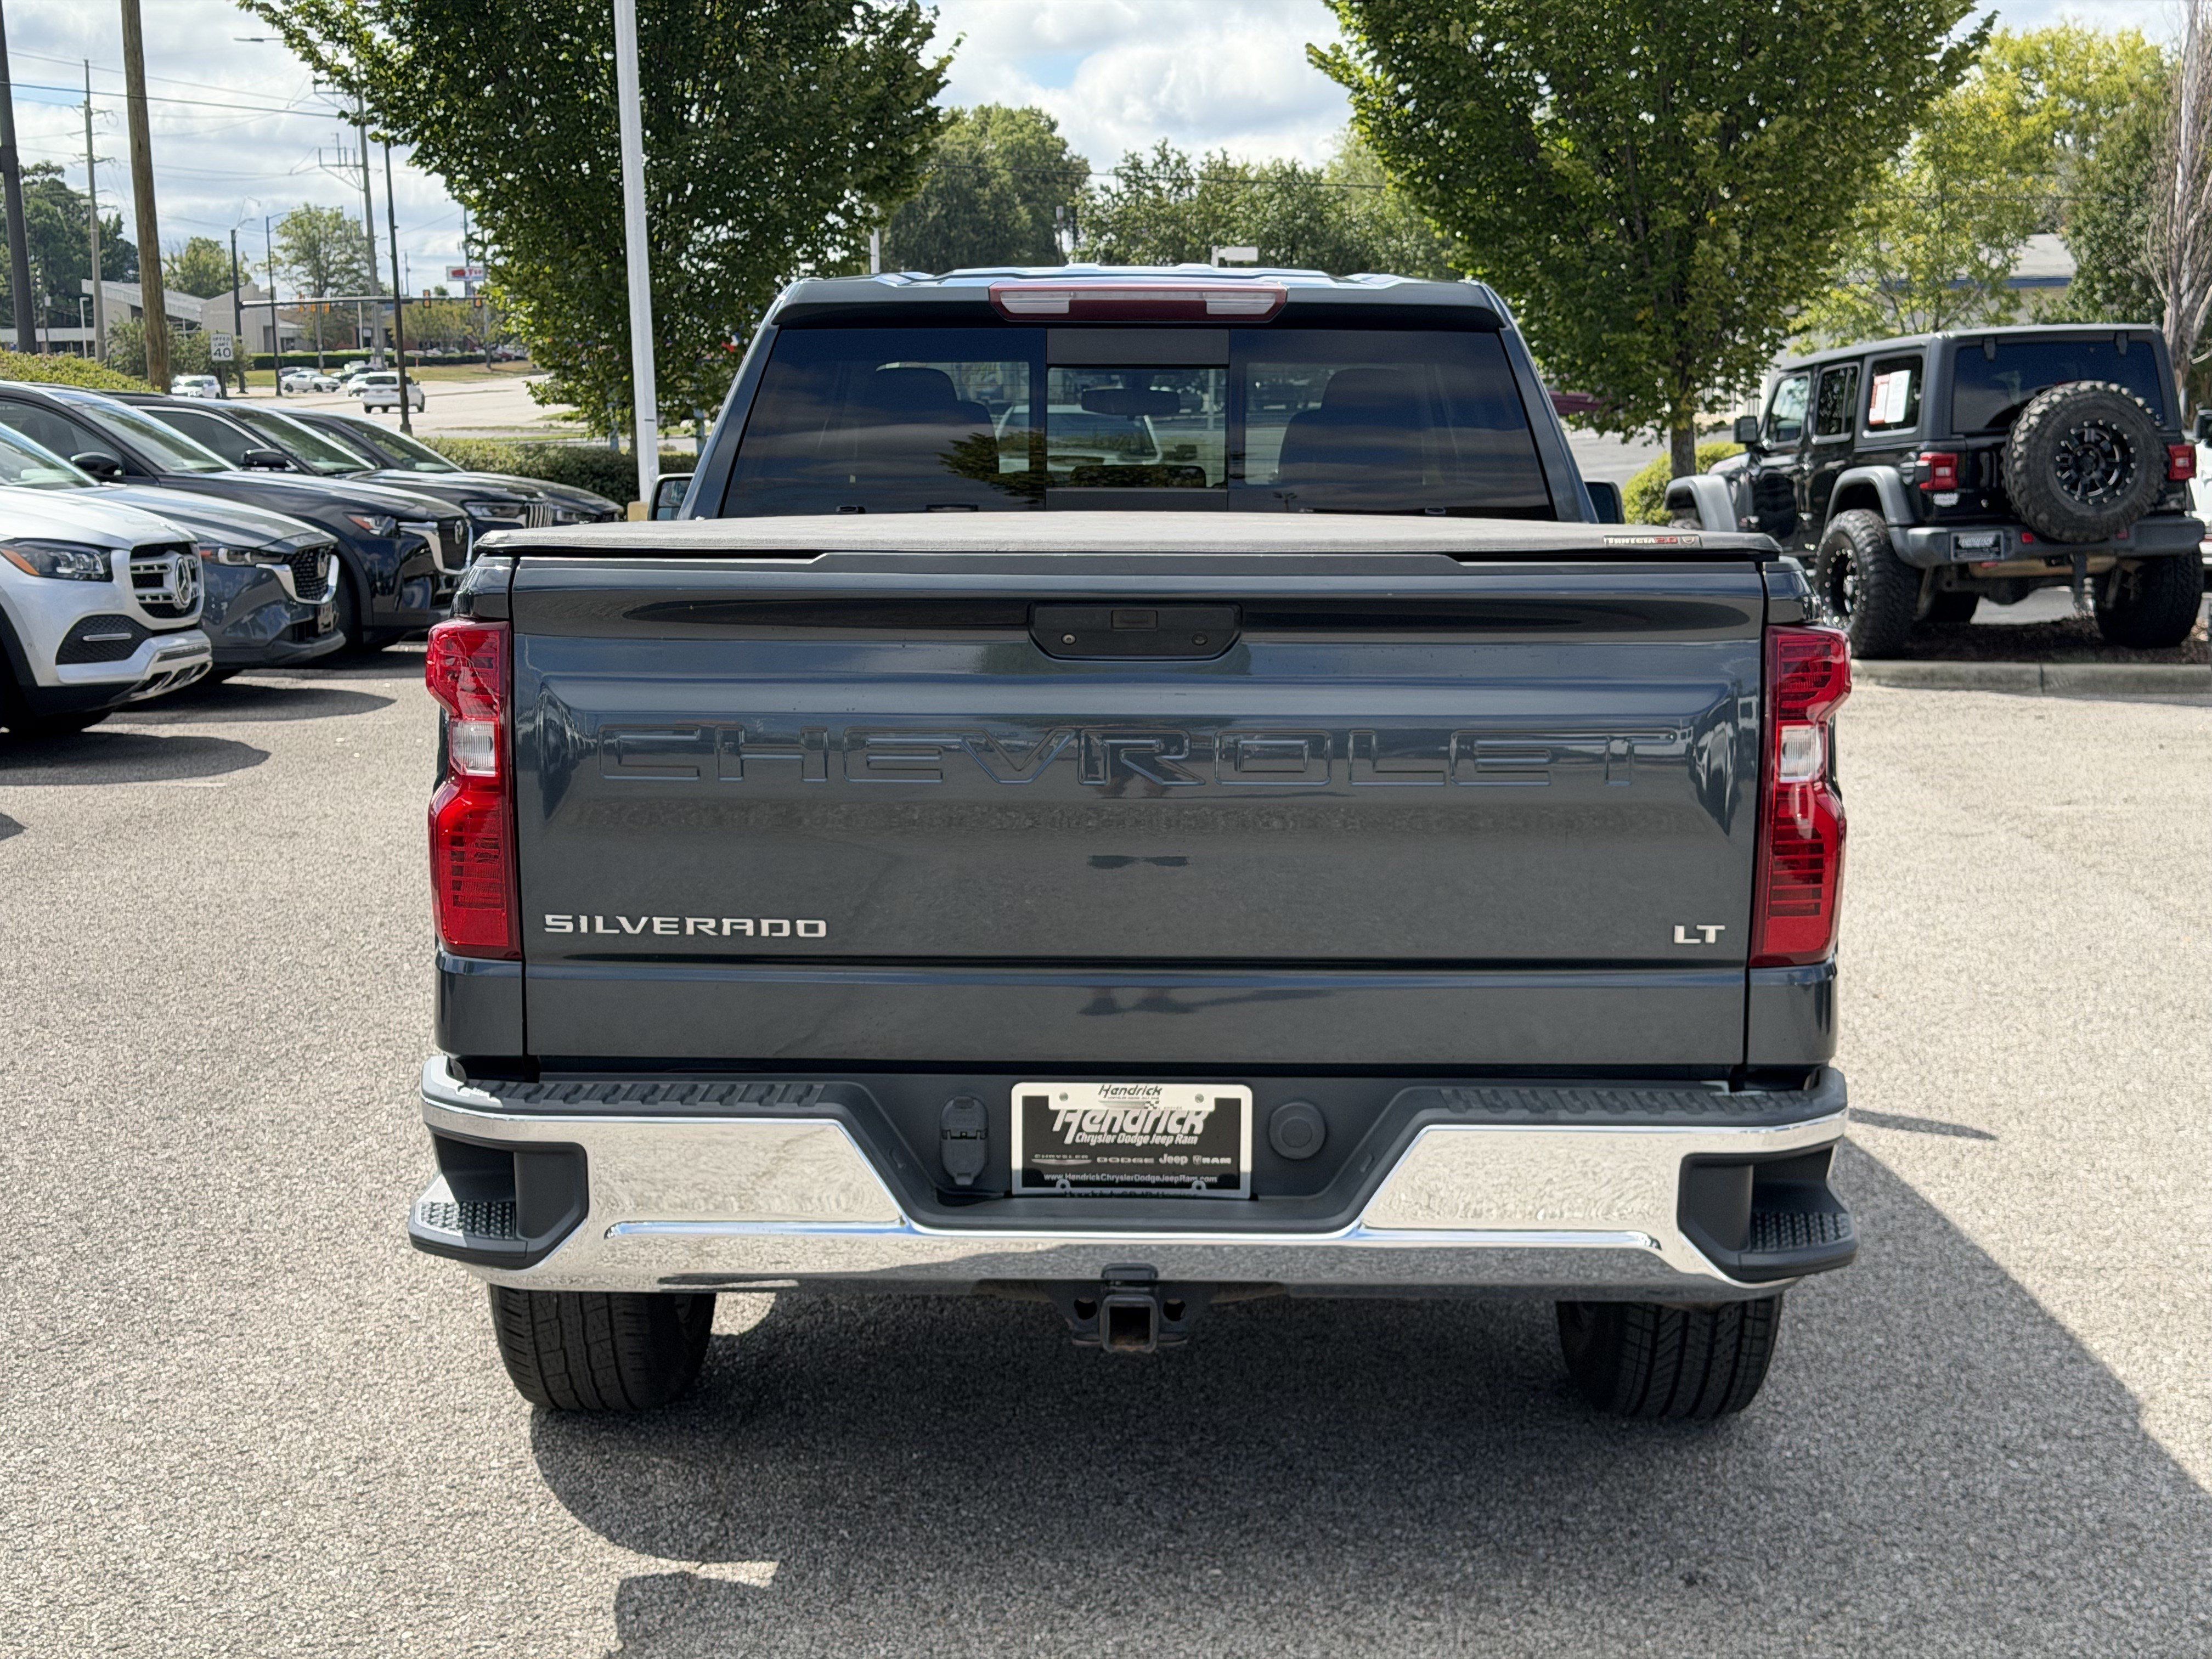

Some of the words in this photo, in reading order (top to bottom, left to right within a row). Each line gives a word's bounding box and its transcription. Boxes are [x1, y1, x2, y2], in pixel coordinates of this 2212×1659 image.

[213, 347, 231, 358] 40
[599, 724, 1677, 786] CHEVROLET
[545, 914, 827, 938] SILVERADO
[1674, 924, 1725, 943] LT
[1052, 1109, 1209, 1144] Hendrick
[1075, 1132, 1116, 1146] Chrysler
[1117, 1132, 1150, 1147] Dodge
[1150, 1133, 1174, 1147] Jeep
[1175, 1133, 1199, 1145] Ram
[1159, 1153, 1188, 1166] Jeep
[1043, 1172, 1218, 1184] www.HendrickChryslerDodgeJeepRam.com
